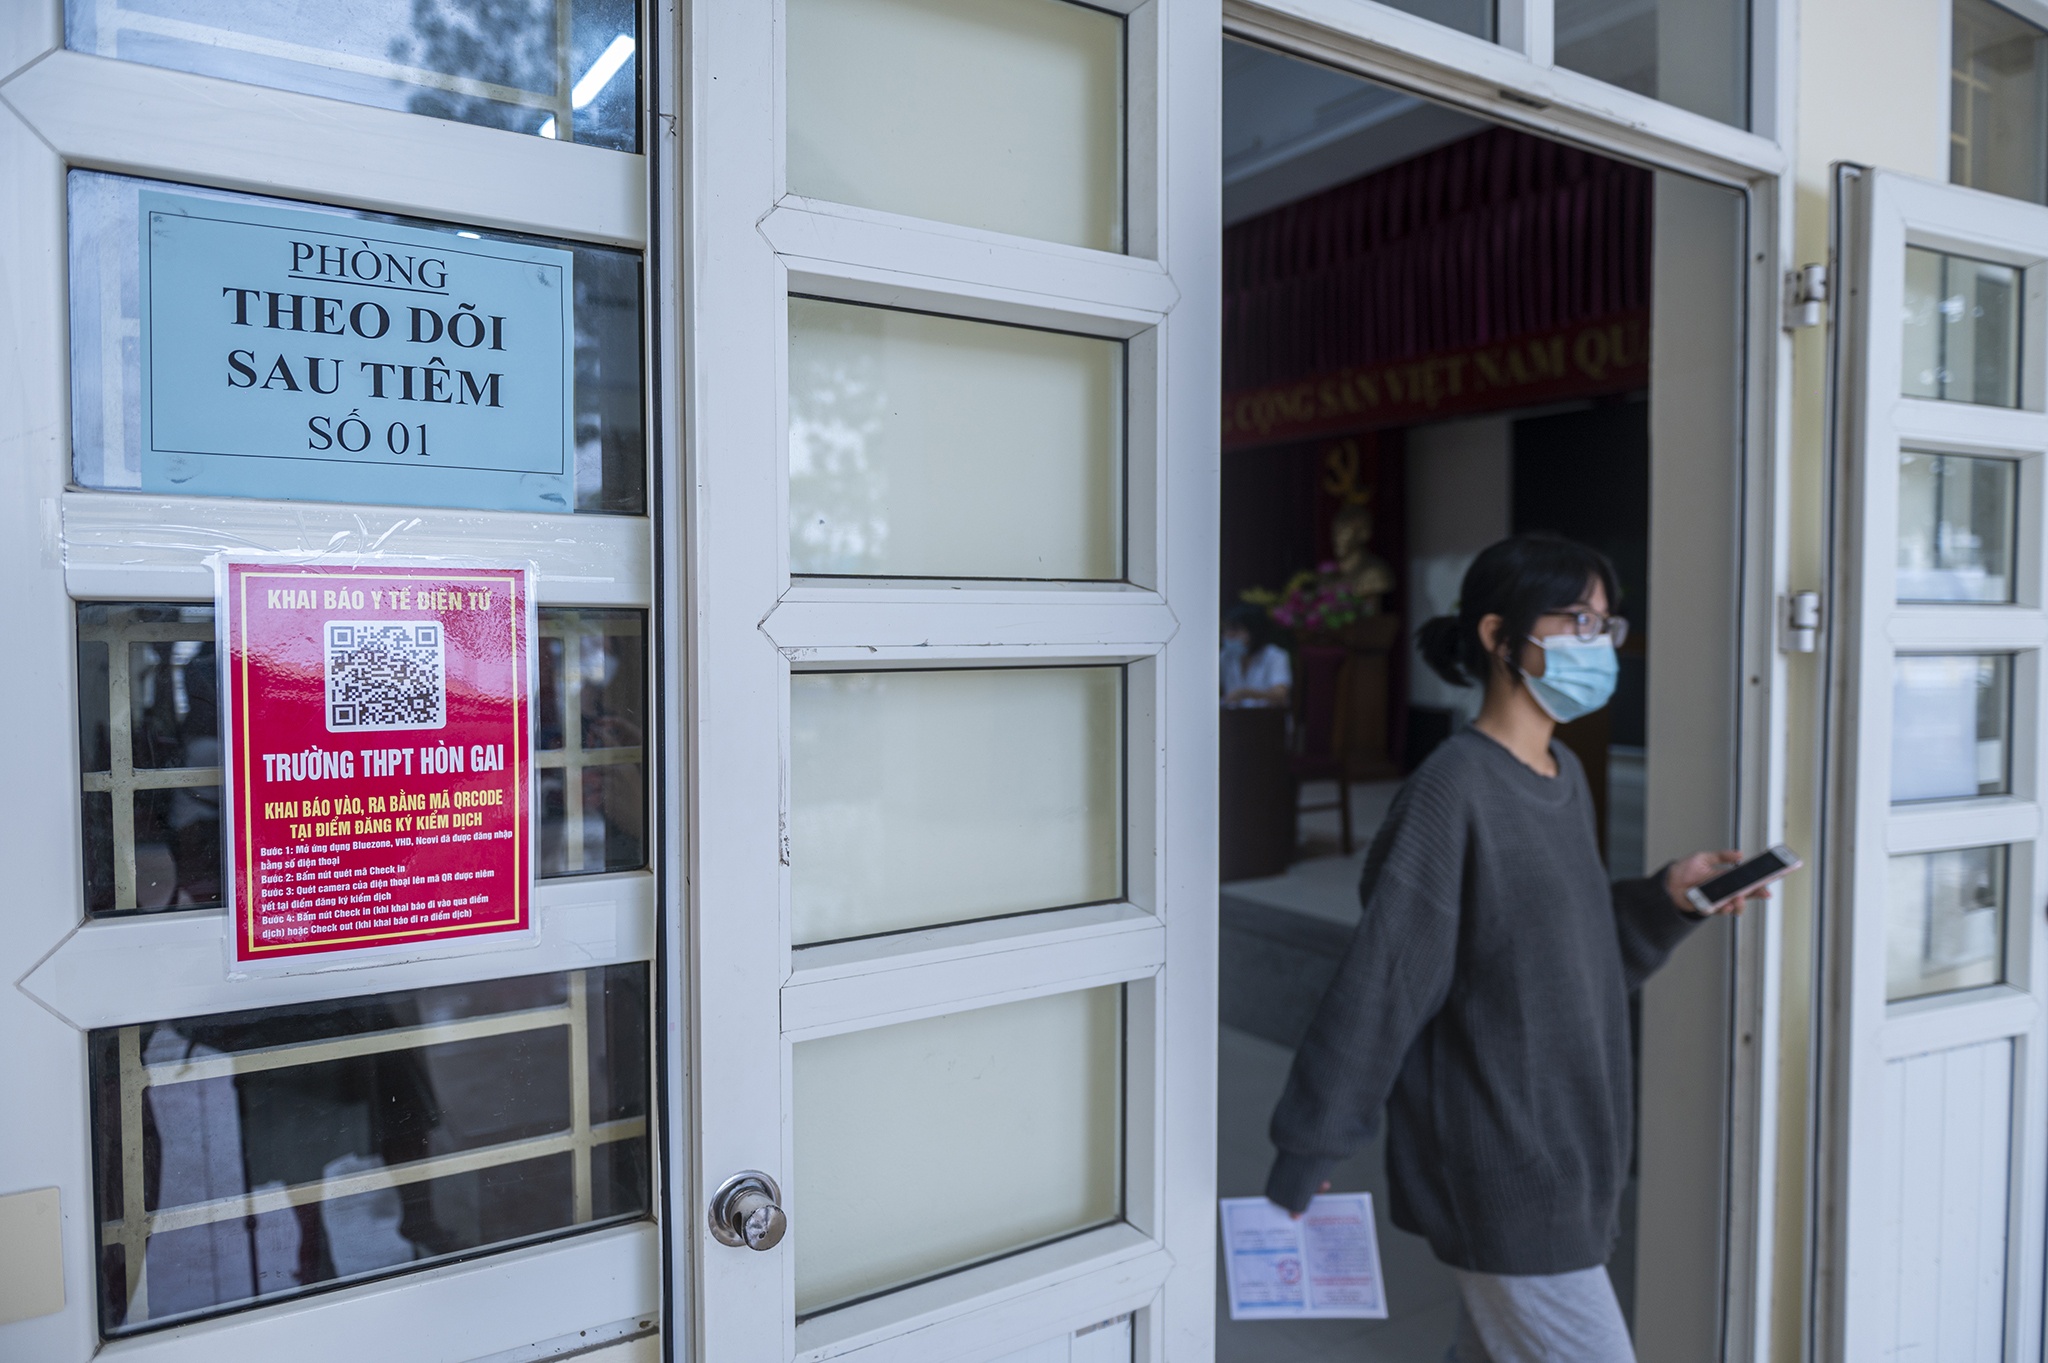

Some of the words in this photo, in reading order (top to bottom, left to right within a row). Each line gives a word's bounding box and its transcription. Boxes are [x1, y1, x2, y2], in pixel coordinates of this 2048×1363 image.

[289, 241, 449, 288] PHÒNG
[222, 287, 390, 339] THEO
[407, 302, 507, 351] DÕI
[228, 349, 344, 394] SAU
[361, 356, 504, 408] TIÊM
[308, 408, 371, 452] SỐ
[387, 422, 430, 456] 01
[267, 589, 317, 610] KHAI
[324, 586, 364, 610] BÁO
[371, 590, 381, 609] Y
[389, 585, 412, 610] TẾ
[417, 588, 462, 614] ĐIỆN
[262, 745, 354, 782] TRƯỜNG
[361, 748, 414, 777] THPT
[421, 740, 464, 775] HÒN
[471, 744, 504, 772] GAI
[265, 801, 298, 820] KHAI
[302, 796, 330, 817] BÁO
[334, 794, 364, 816] VÀO,
[368, 796, 386, 813] RA
[390, 789, 426, 812] BẰNG
[430, 789, 450, 810] MÃ
[454, 789, 503, 809] QRCODE
[290, 823, 312, 841] TẠI
[315, 816, 351, 837] ĐIỂM
[355, 817, 392, 835] ĐĂNG
[395, 814, 412, 832] KÝ
[416, 810, 449, 830] KIỂM
[453, 812, 482, 830] DỊCH
[352, 840, 394, 850] Bluezone,
[318, 884, 350, 893] camera
[442, 873, 452, 882] QR
[370, 865, 395, 875] Check
[397, 864, 406, 873] in
[334, 908, 361, 918] Check
[363, 907, 371, 915] in
[391, 903, 409, 912] khai
[453, 898, 467, 906] qua
[311, 924, 337, 934] Check
[340, 922, 353, 931] out
[373, 918, 391, 927] khai
